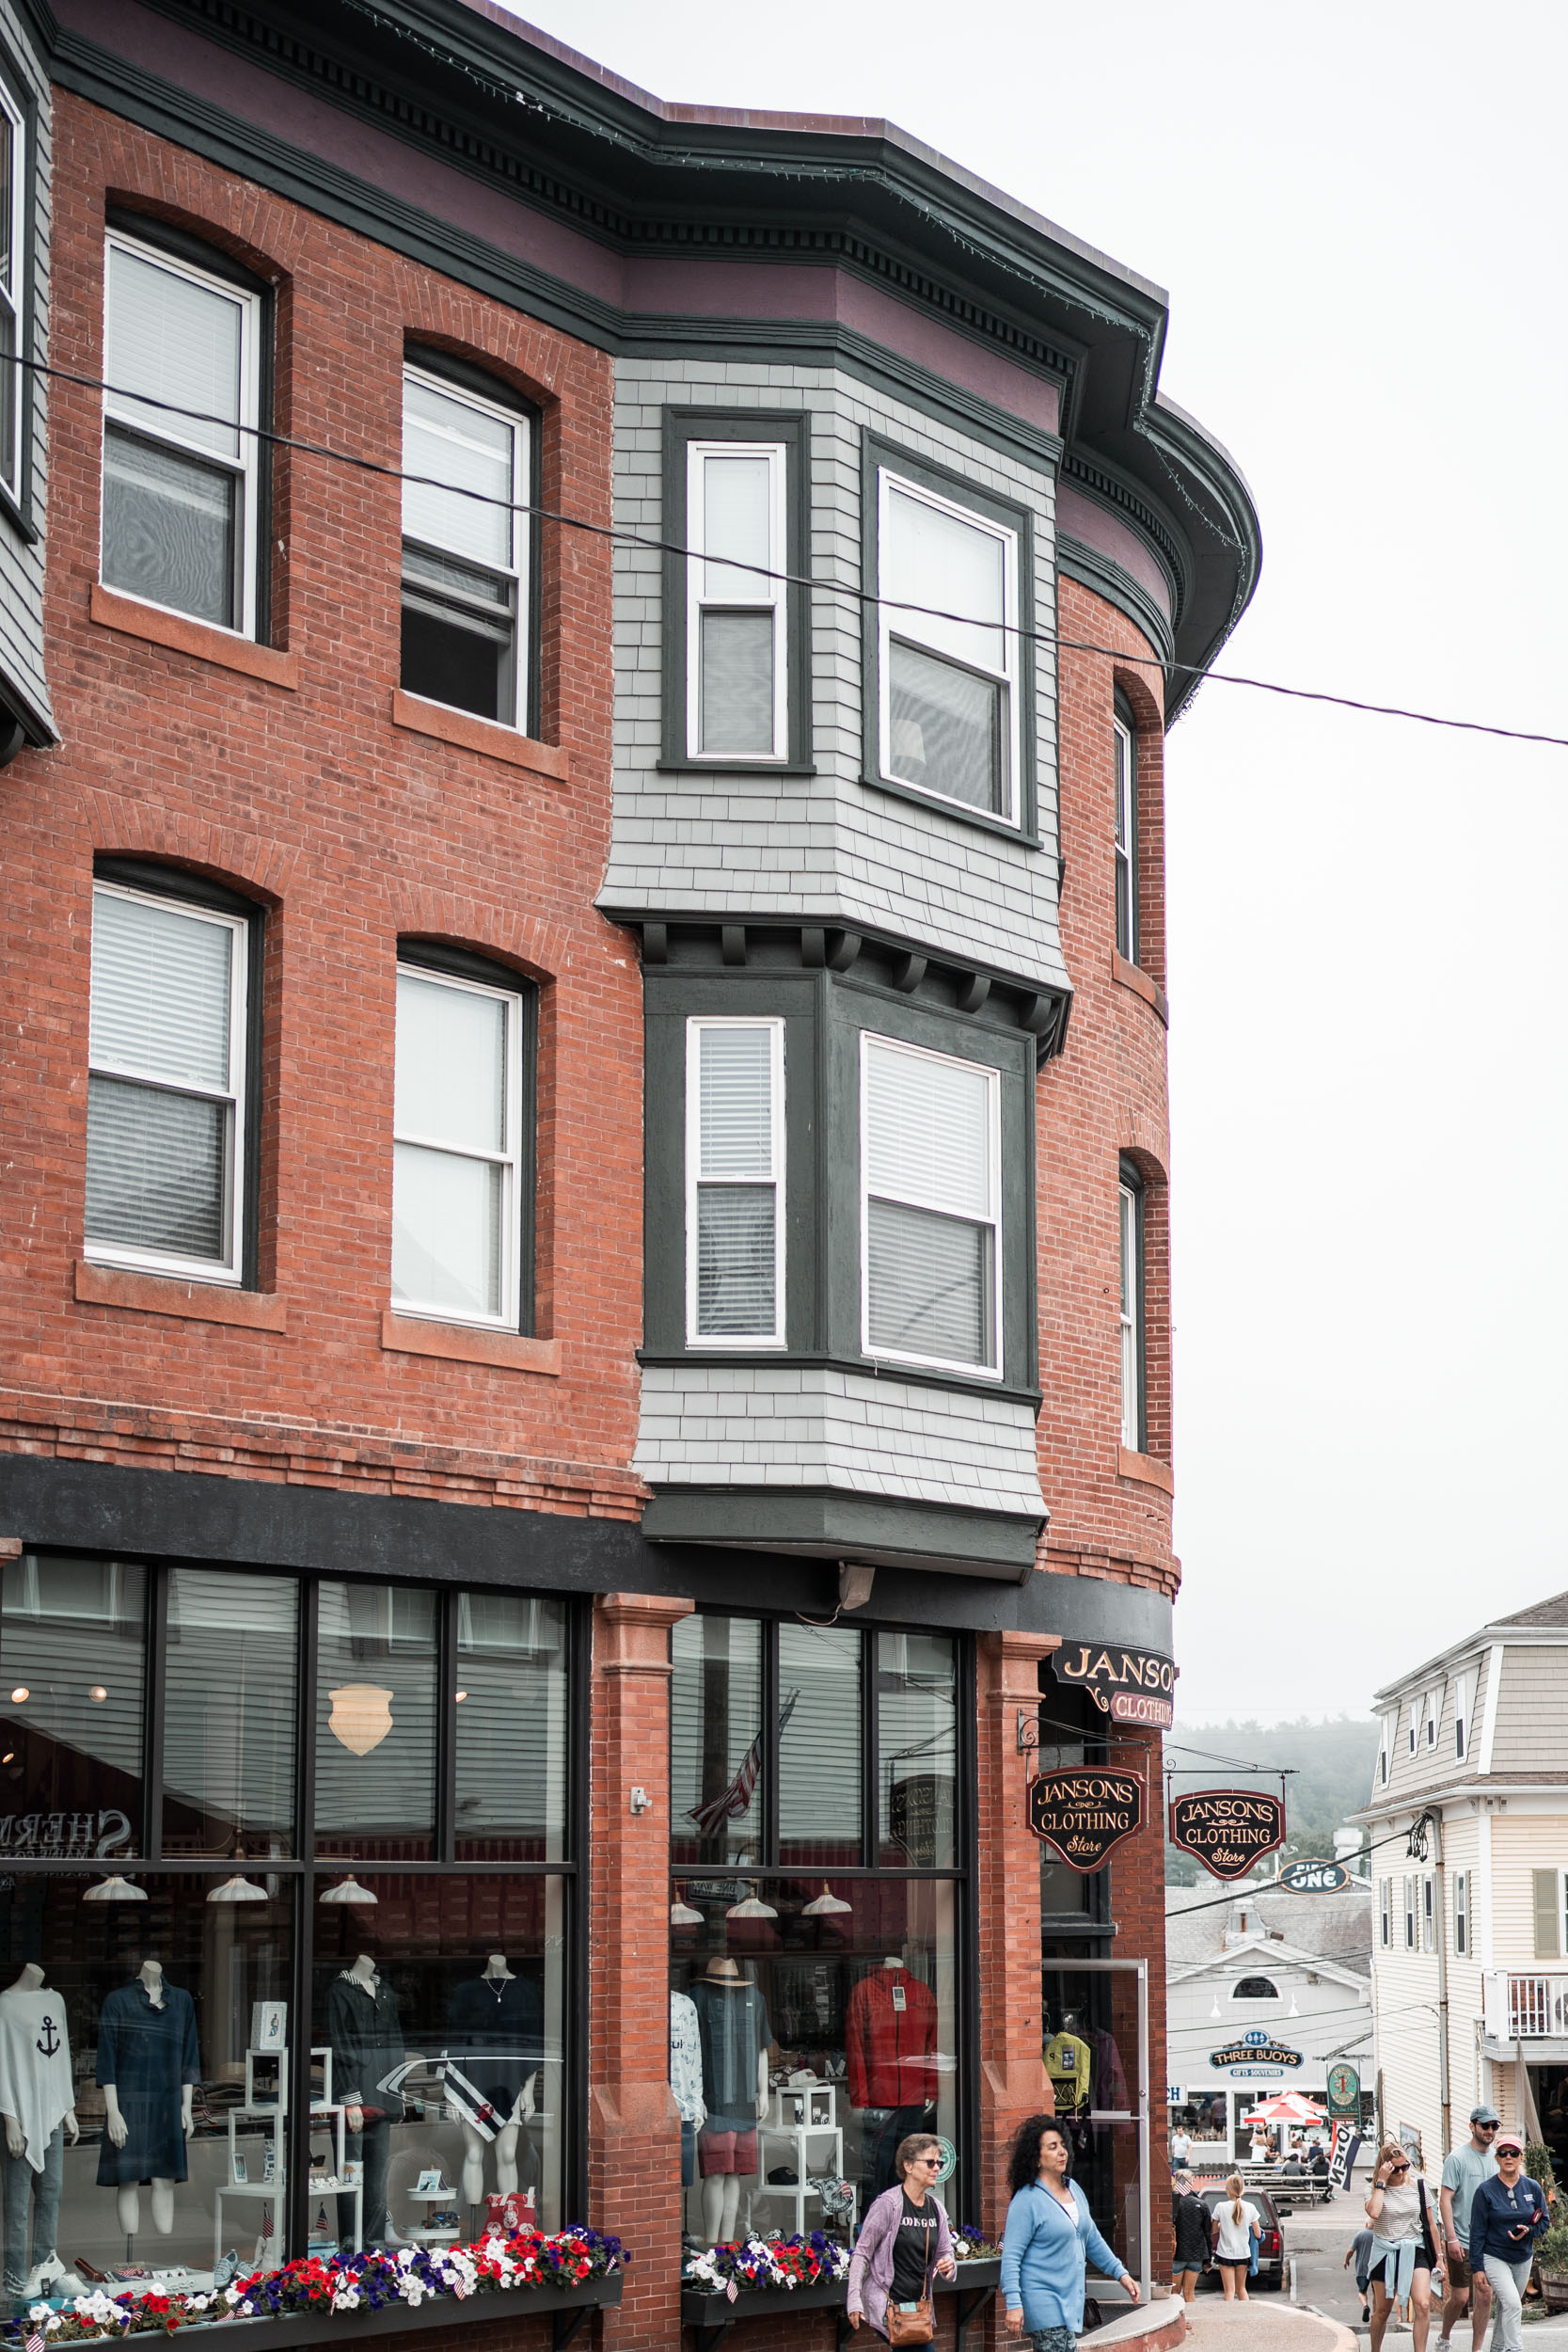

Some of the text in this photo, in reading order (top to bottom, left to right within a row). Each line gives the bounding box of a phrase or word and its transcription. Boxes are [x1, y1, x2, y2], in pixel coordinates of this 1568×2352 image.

[1064, 1647, 1174, 1693] JANSO
[1037, 1779, 1133, 1805] JANSONS
[1181, 1800, 1274, 1822] JANSONS
[1041, 1812, 1130, 1831] CLOTHING
[1067, 1835, 1102, 1852] Store
[1185, 1828, 1272, 1844] CLOTHING
[1211, 1847, 1246, 1863] Store
[1291, 1870, 1337, 1888] ONE
[1214, 2049, 1298, 2064] THREE BUOYS
